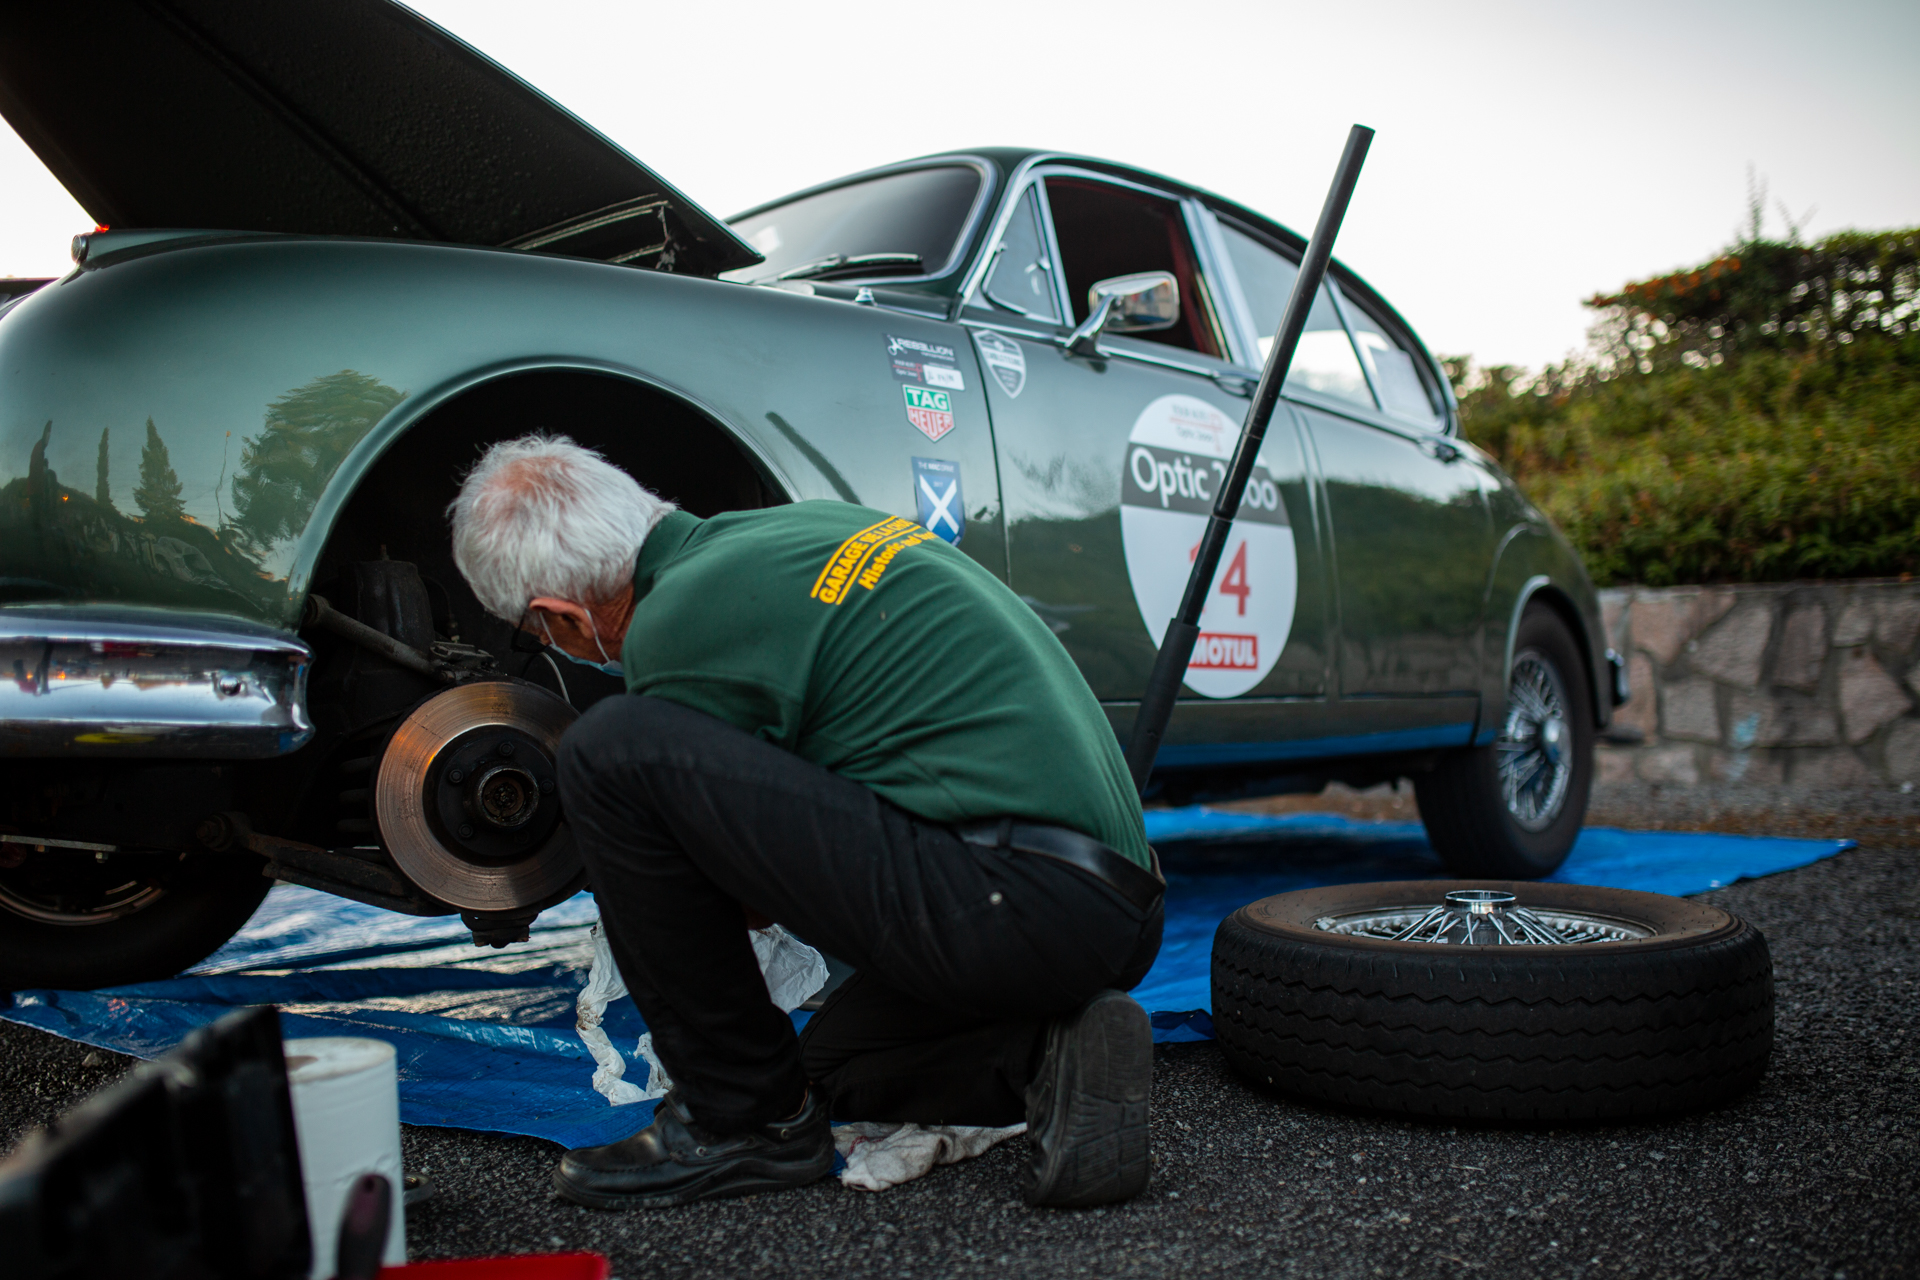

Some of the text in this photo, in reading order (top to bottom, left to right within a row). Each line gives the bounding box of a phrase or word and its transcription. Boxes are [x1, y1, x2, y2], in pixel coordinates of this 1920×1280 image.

[897, 338, 955, 357] REBELLION
[906, 388, 949, 411] TAG
[909, 408, 953, 437] HEUER
[1130, 446, 1278, 511] Optic 200
[819, 540, 869, 604] GARAGE
[1193, 636, 1257, 667] MOTUL
